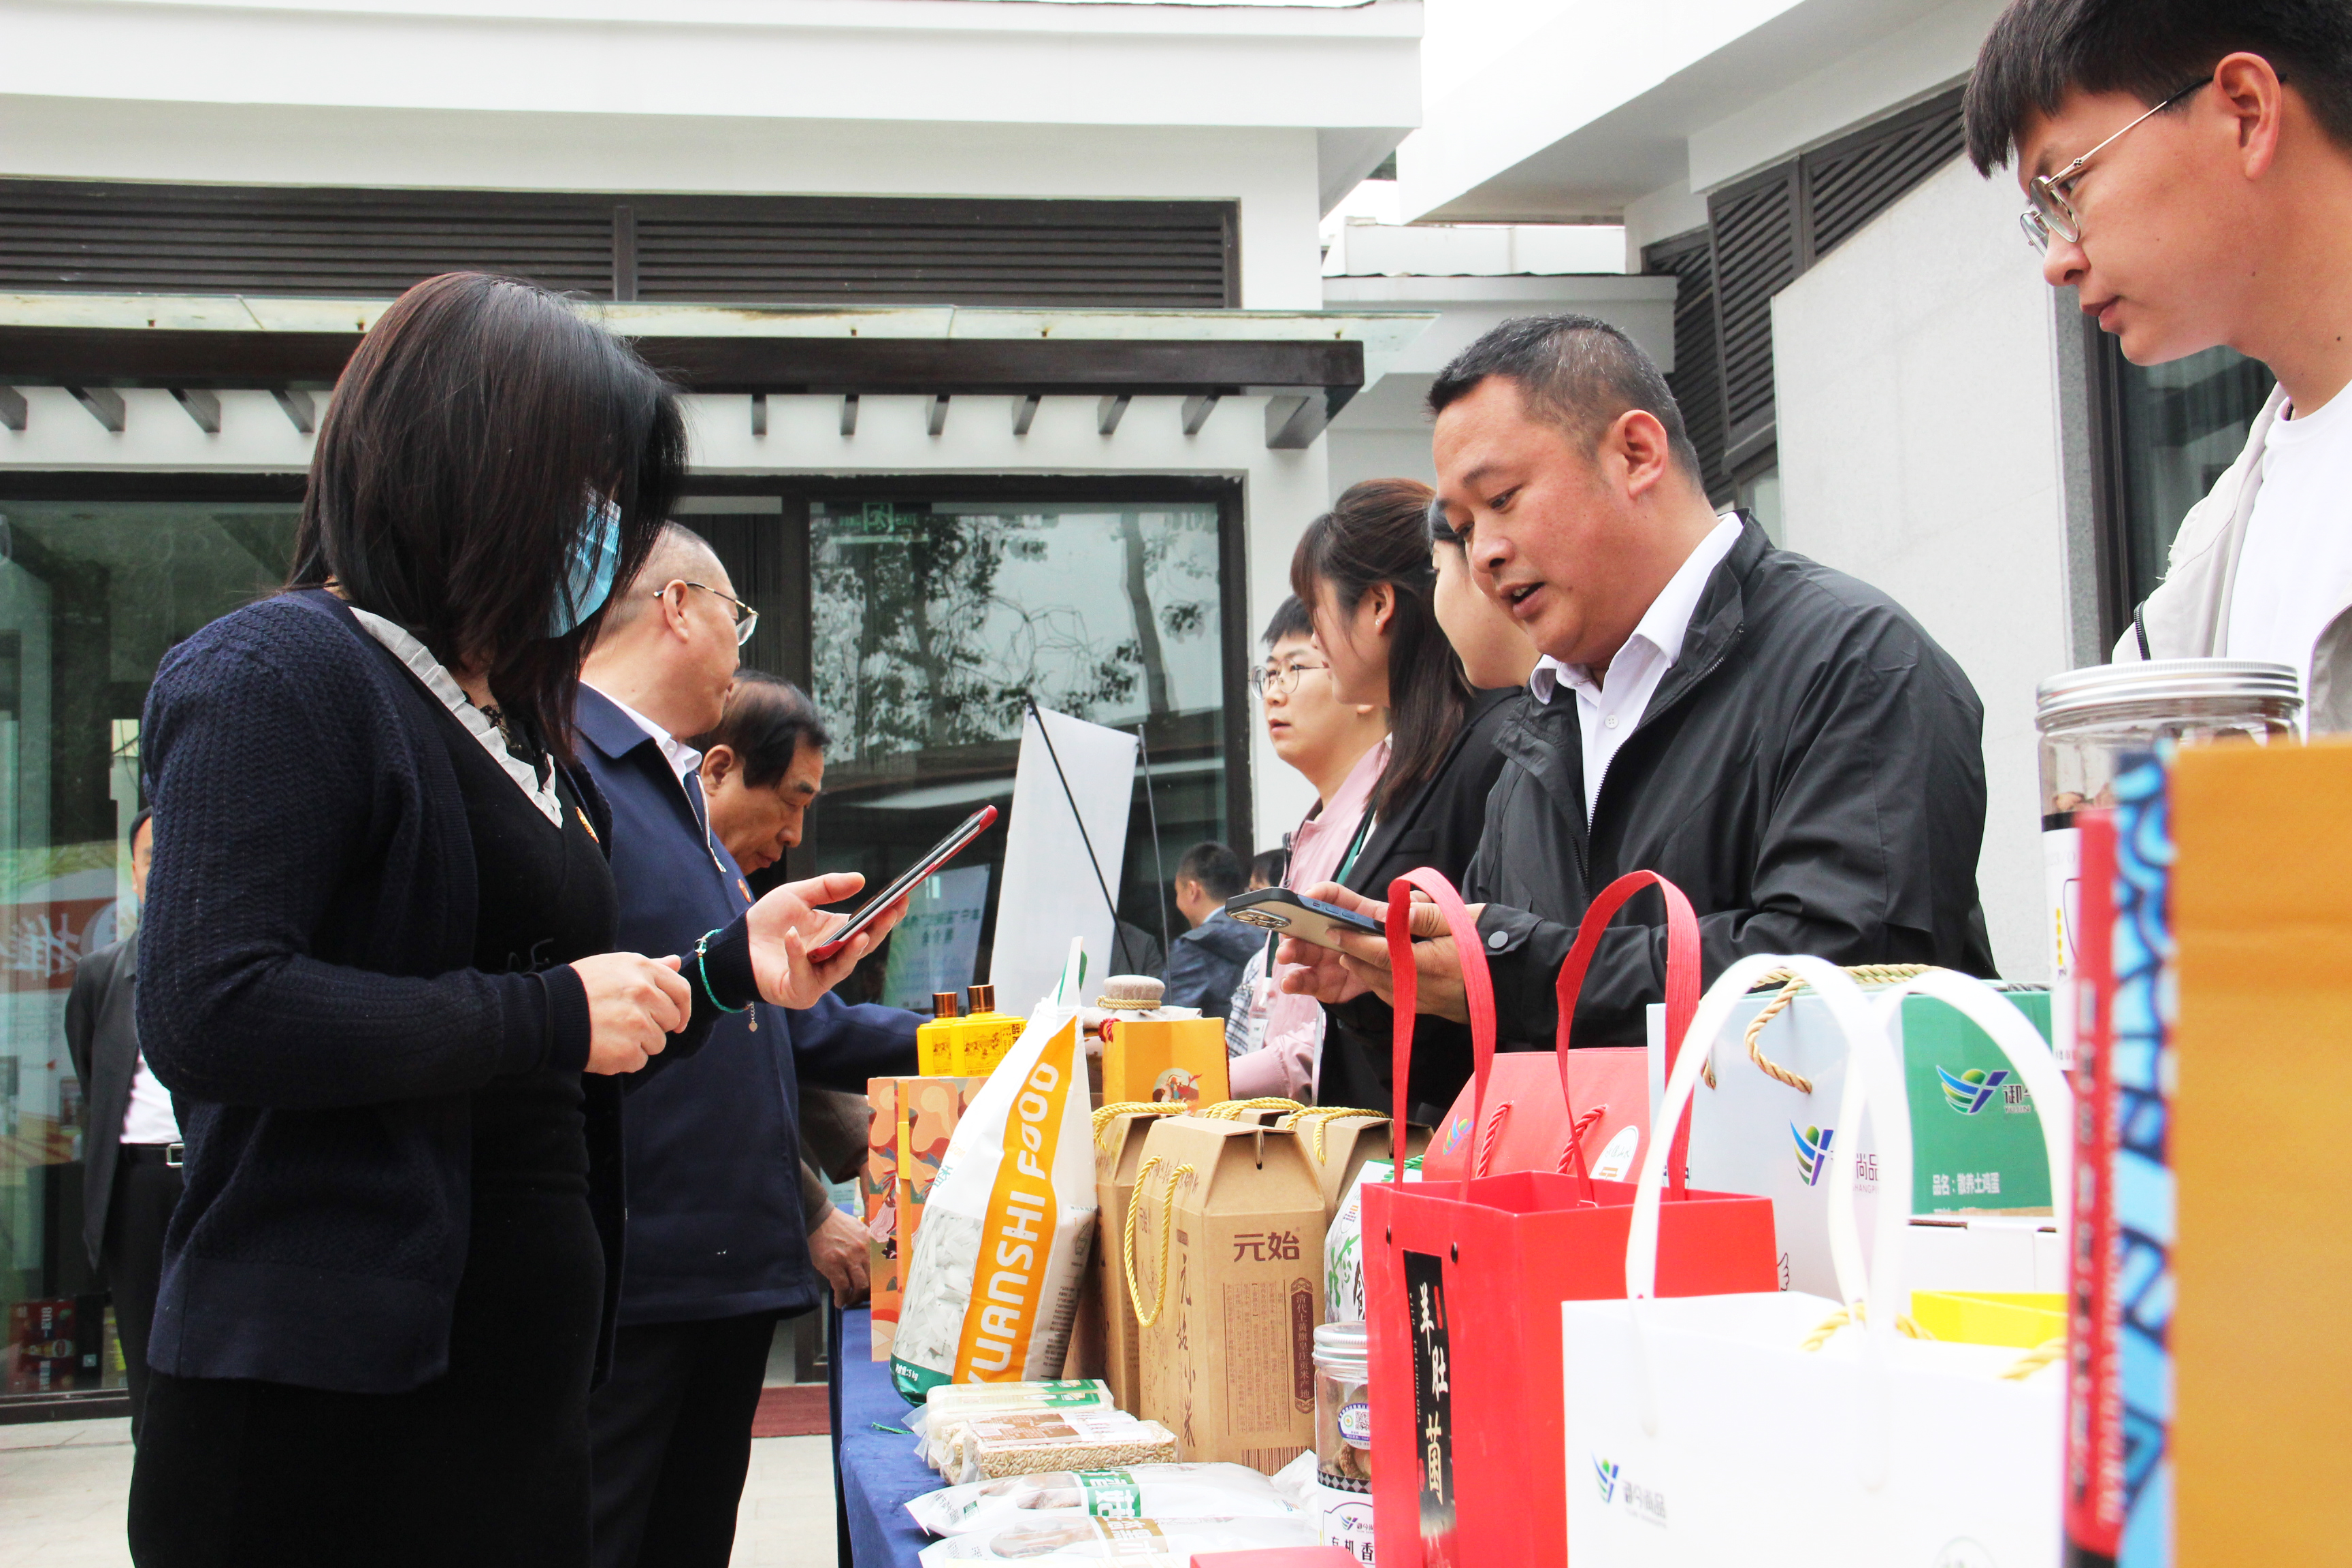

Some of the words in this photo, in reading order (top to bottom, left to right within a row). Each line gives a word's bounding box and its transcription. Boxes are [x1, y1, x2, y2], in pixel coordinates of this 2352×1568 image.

[1016, 1062, 1060, 1181] FOOD
[1233, 1230, 1301, 1262] 元始
[1419, 1281, 1449, 1505] 羊肚菌
